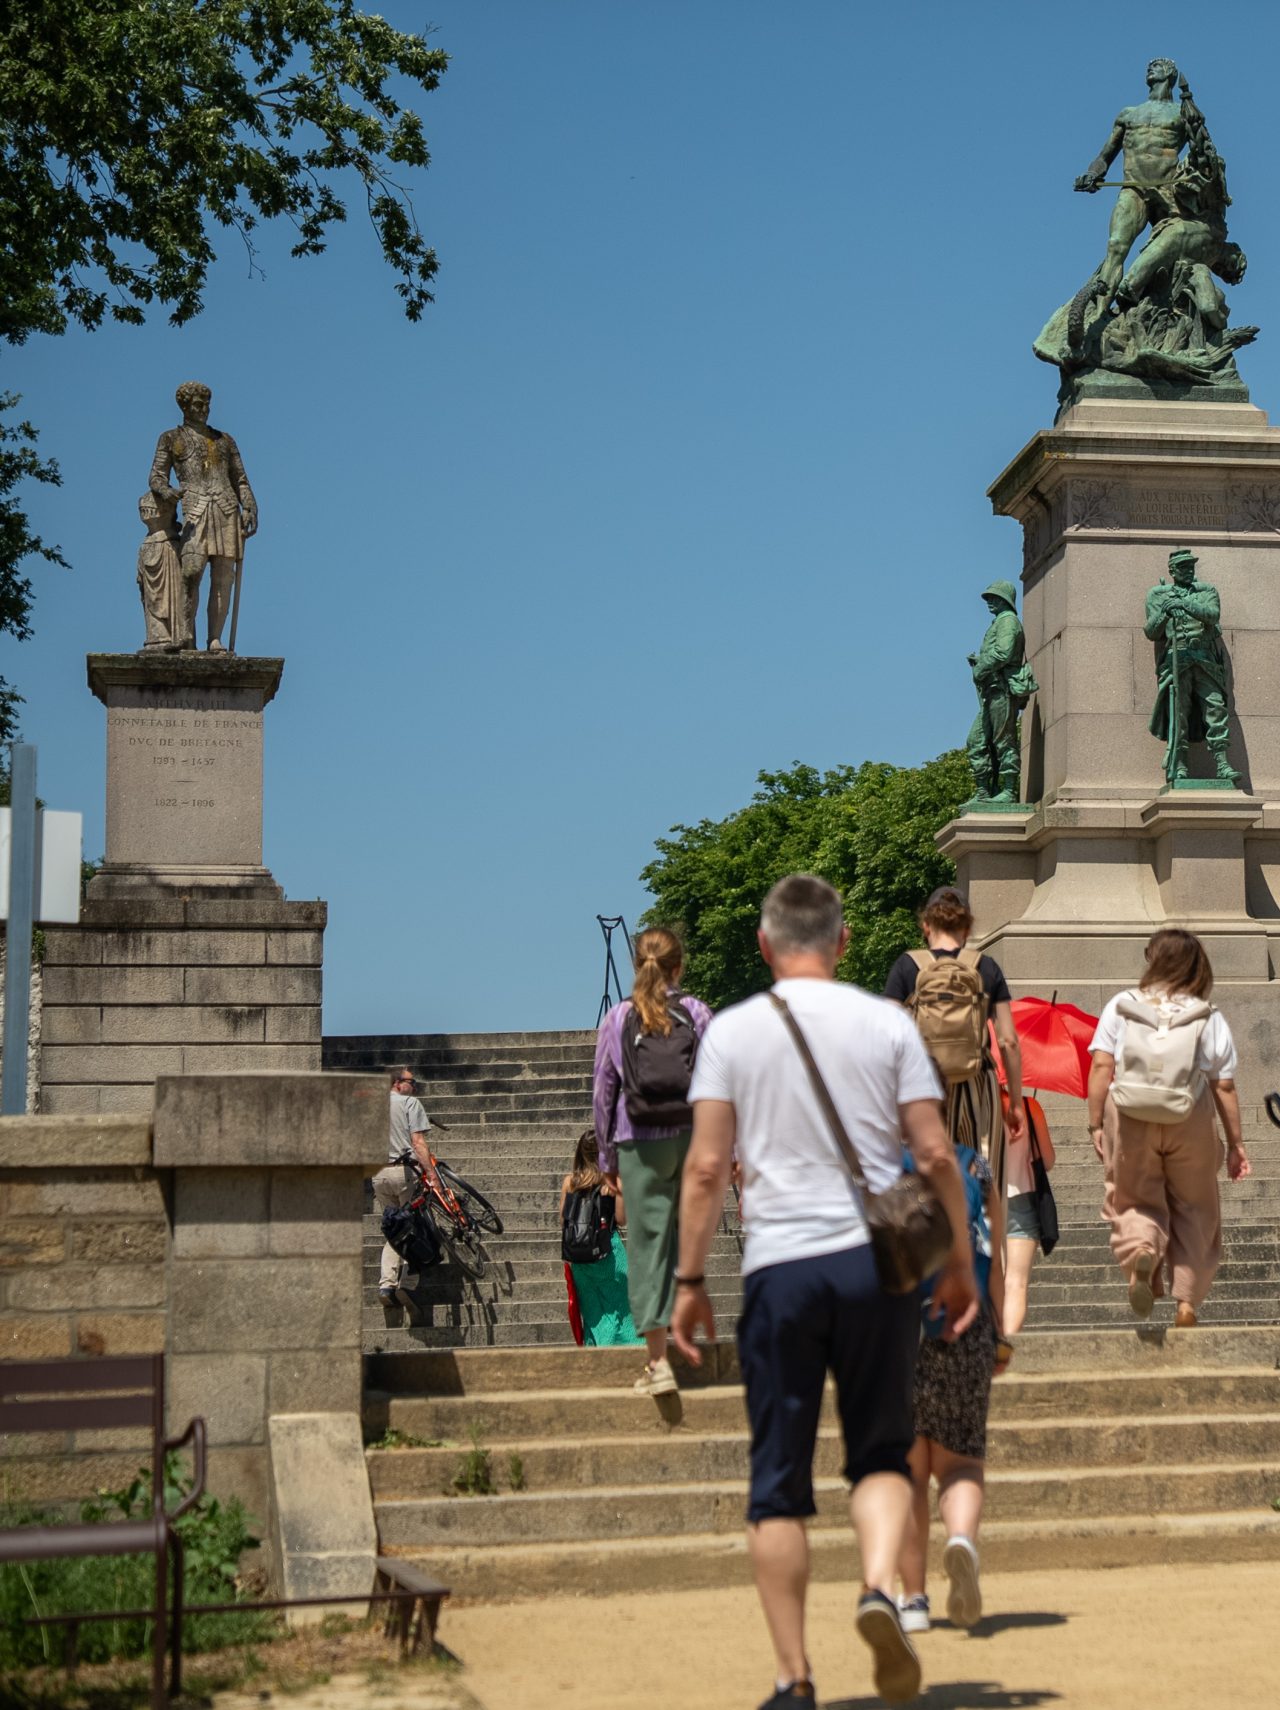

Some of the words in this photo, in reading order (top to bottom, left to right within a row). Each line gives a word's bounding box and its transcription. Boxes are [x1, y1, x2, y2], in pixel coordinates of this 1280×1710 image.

[1139, 491, 1159, 502] AUX
[1168, 491, 1213, 503] ENFANTS
[1129, 513, 1159, 525] MORTS
[1161, 514, 1183, 525] POUR
[1185, 514, 1195, 526] LA
[194, 719, 209, 728] DE
[215, 720, 264, 730] FRANCE
[129, 737, 153, 747] DVC
[159, 738, 174, 747] DE
[180, 738, 243, 748] BRETAGNE
